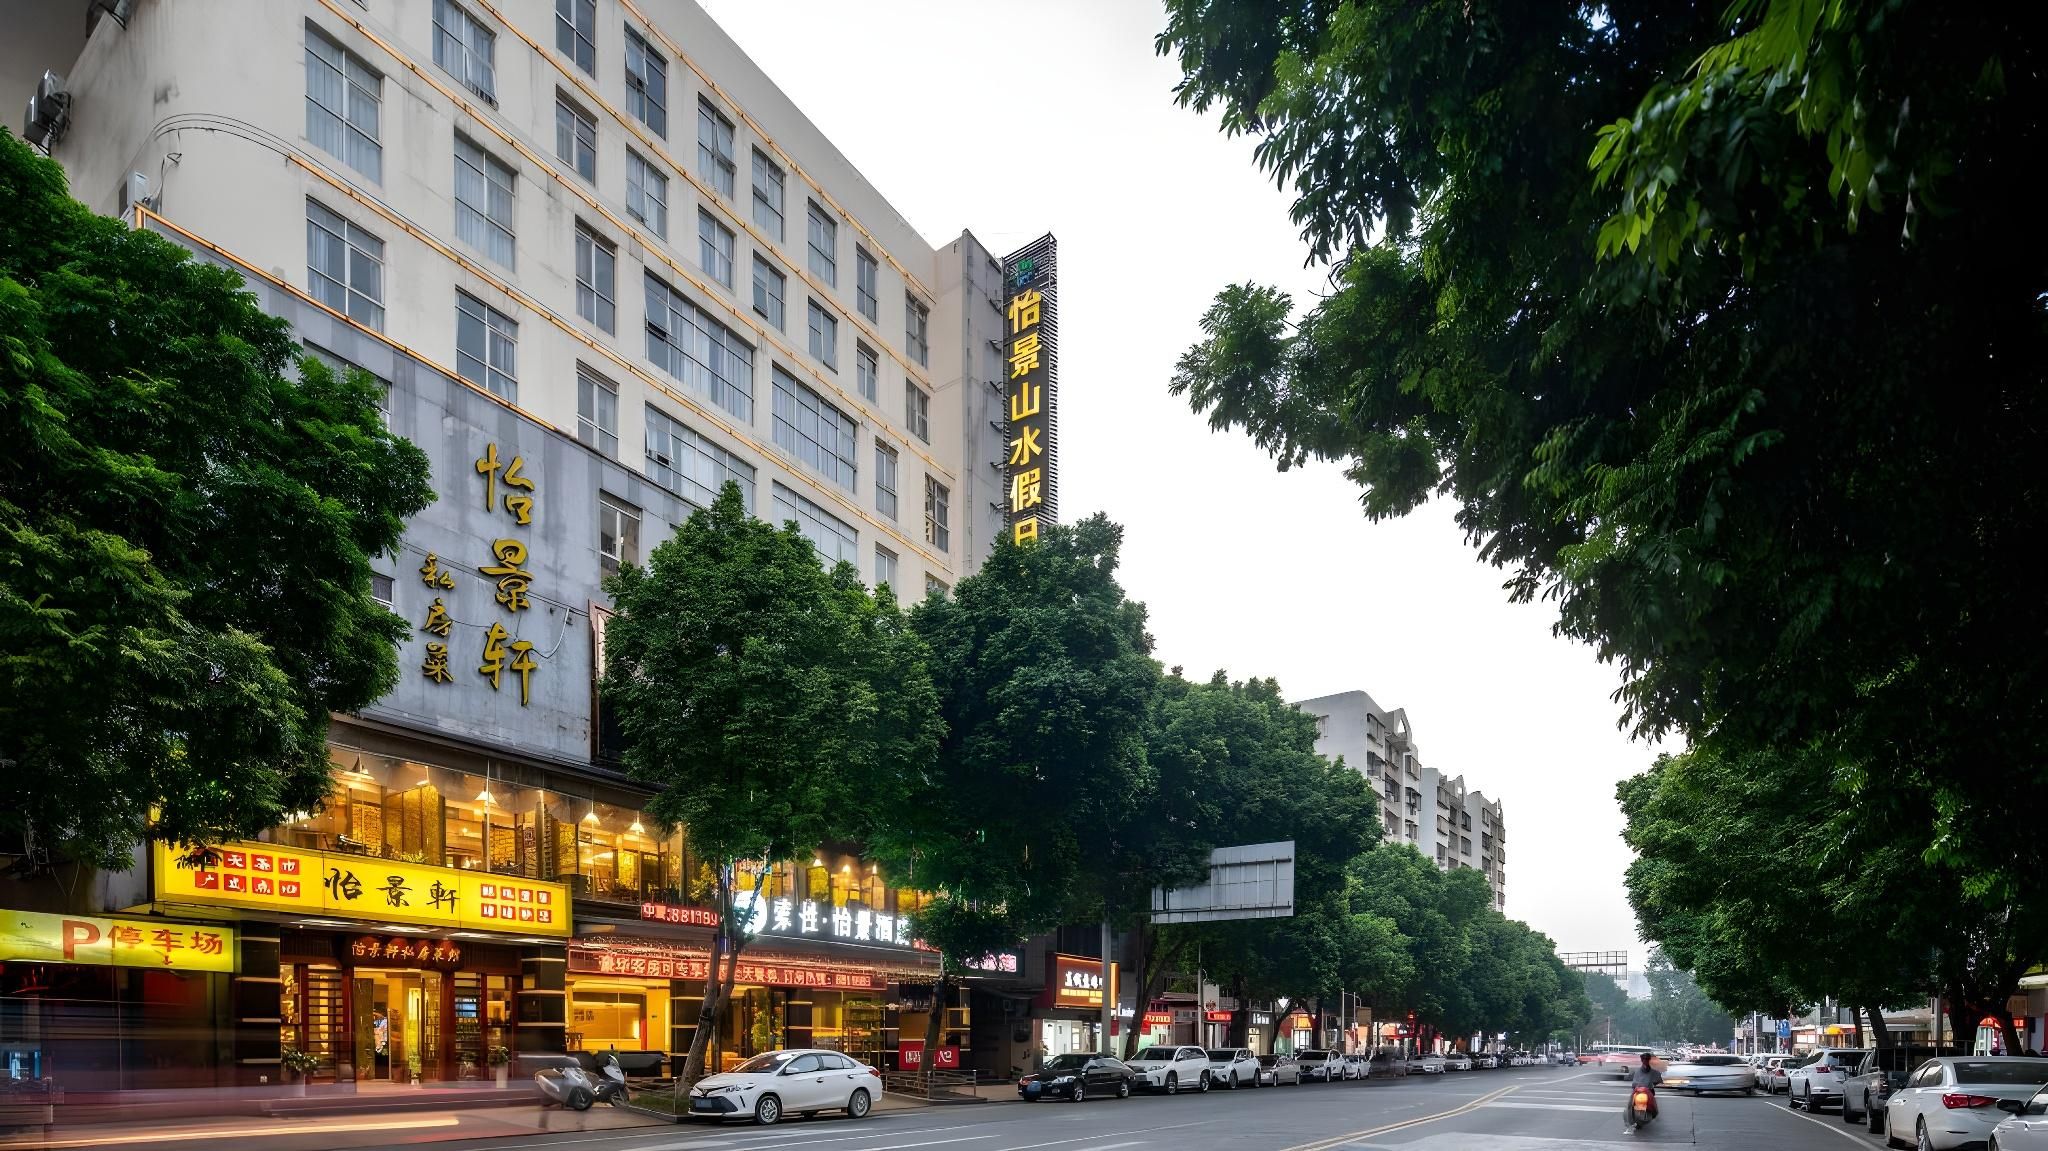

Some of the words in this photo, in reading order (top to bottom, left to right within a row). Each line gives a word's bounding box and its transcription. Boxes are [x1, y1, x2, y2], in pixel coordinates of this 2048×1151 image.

[1008, 288, 1043, 548] 怡景山水假日
[419, 552, 456, 683] 私房菜
[108, 925, 223, 955] 停车场
